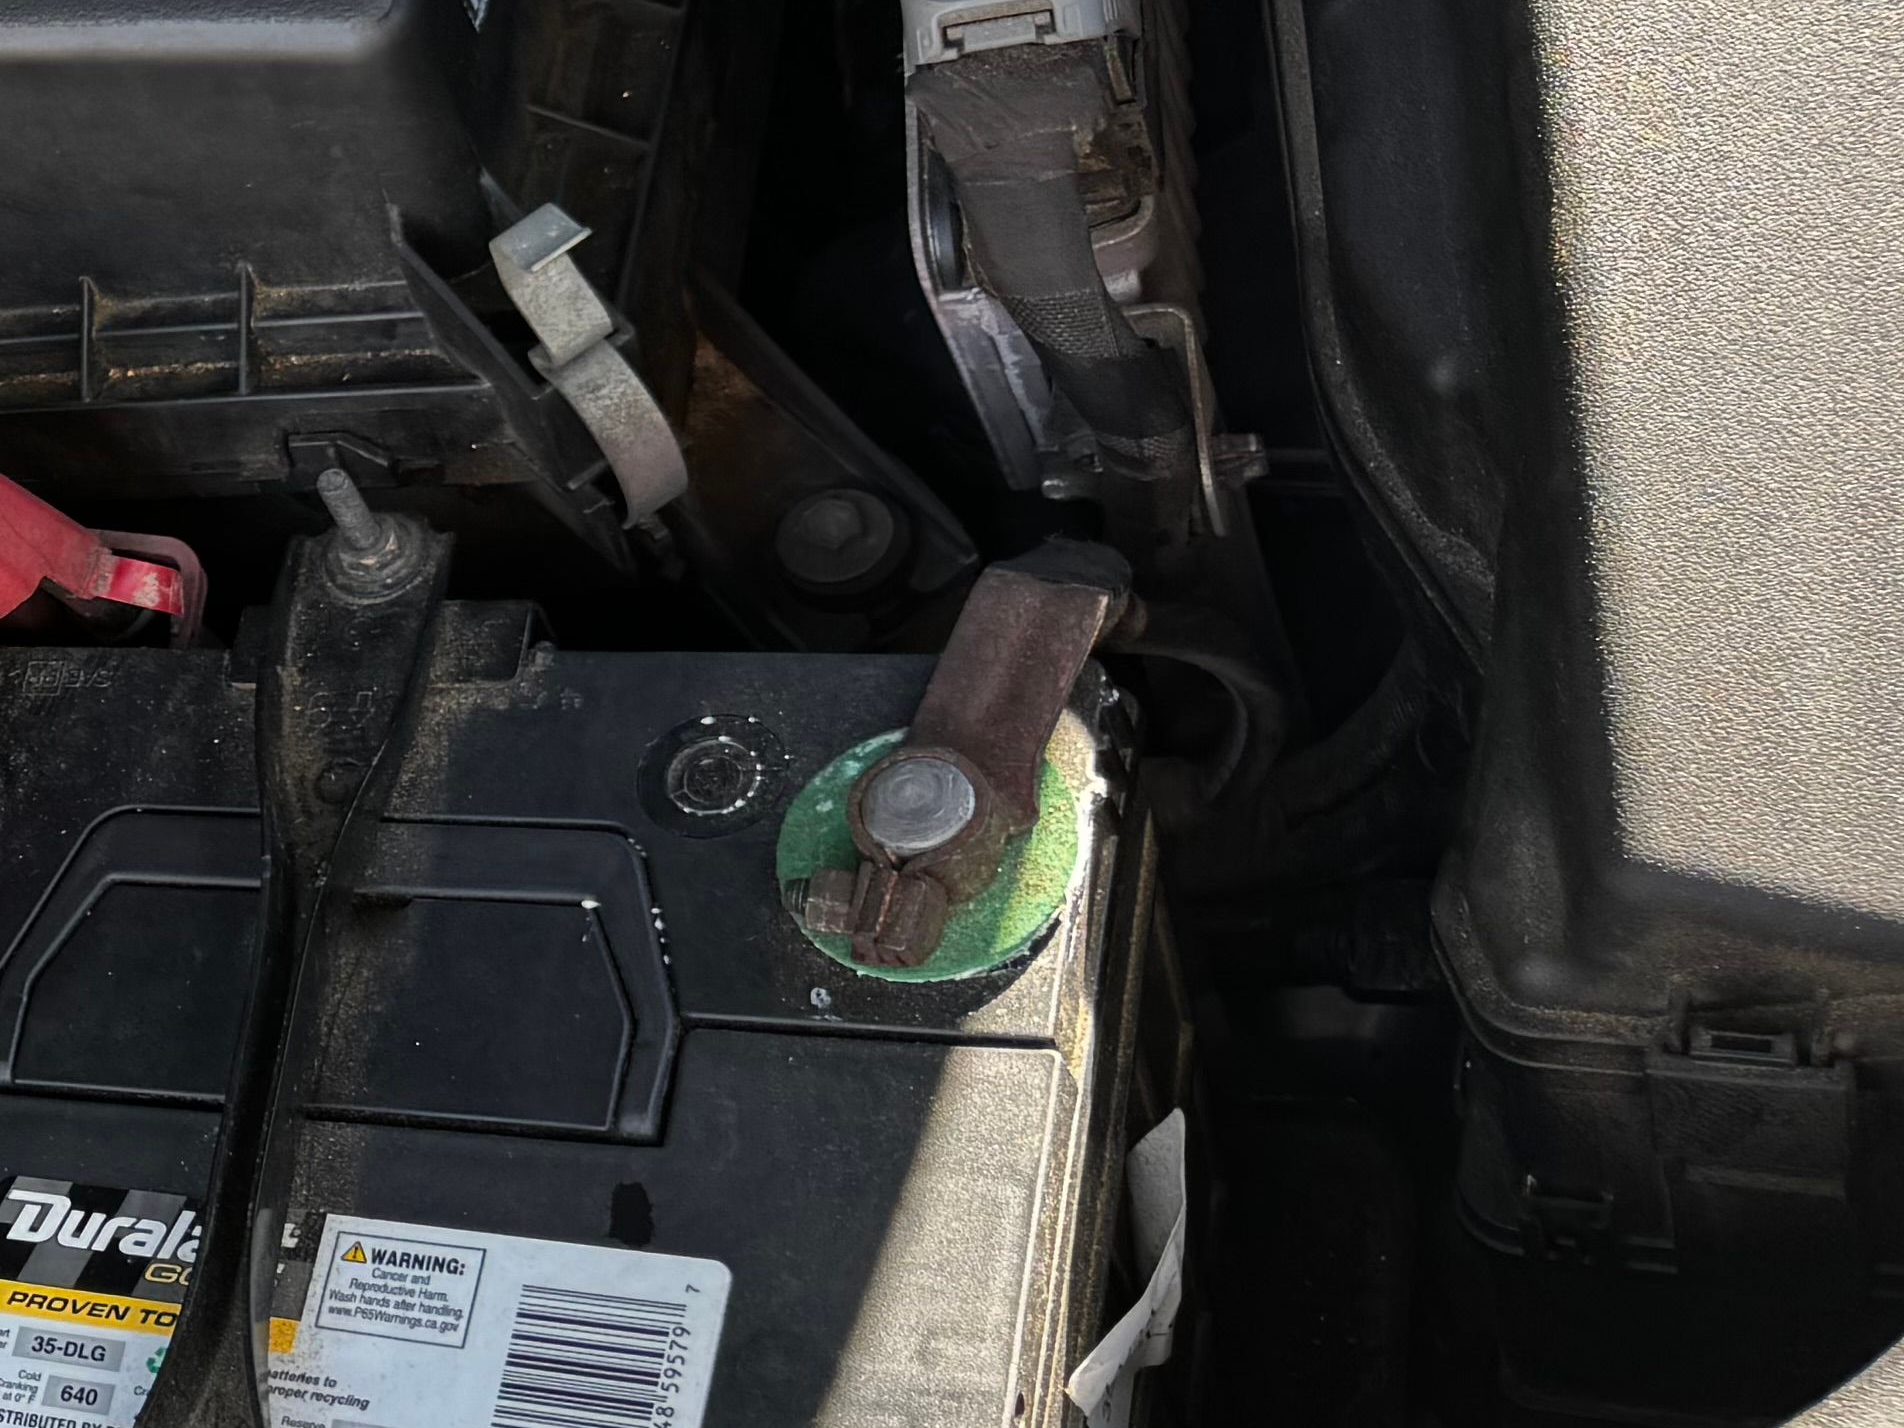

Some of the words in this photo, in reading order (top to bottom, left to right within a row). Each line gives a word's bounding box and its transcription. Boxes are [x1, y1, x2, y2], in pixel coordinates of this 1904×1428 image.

[371, 1247, 466, 1275] WARNING:
[371, 1267, 409, 1285] Cancer
[412, 1273, 431, 1286] and
[349, 1278, 416, 1299] Reproductive
[7, 1291, 131, 1322] PROVEN
[328, 1288, 358, 1303] Wash
[359, 1294, 392, 1310] hands
[393, 1299, 417, 1313] after
[328, 1304, 460, 1334] www.P65Warnings.ca.gov
[31, 1335, 107, 1363] 35-DLG
[660, 1326, 691, 1393] 59579
[686, 1283, 701, 1293] 7
[17, 1369, 42, 1383] Cold
[269, 1370, 320, 1386] atteries
[323, 1375, 338, 1389] to
[3, 1390, 14, 1401] at
[28, 1393, 36, 1404] F
[59, 1384, 99, 1407] 640
[310, 1389, 370, 1412] recycling
